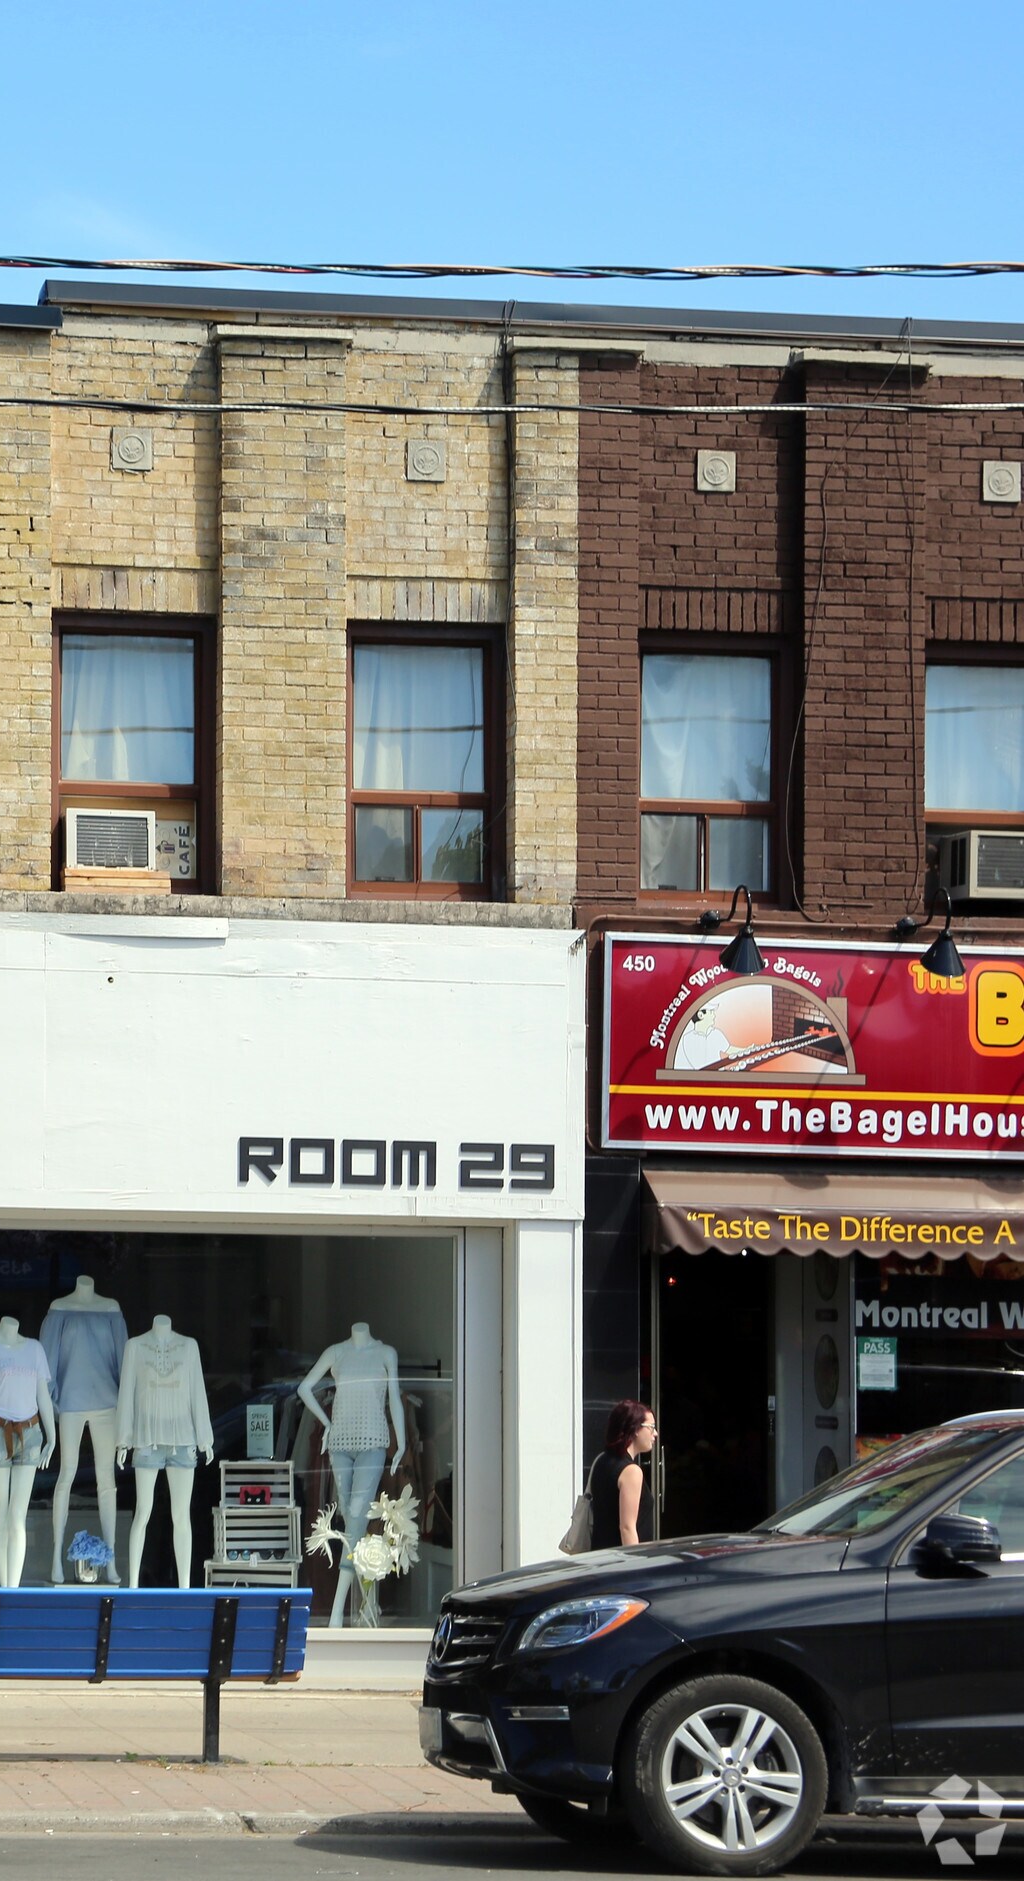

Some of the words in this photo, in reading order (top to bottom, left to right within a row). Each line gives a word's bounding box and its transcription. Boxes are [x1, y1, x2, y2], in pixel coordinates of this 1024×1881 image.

[174, 825, 191, 876] CAFÉ
[623, 955, 655, 972] 450
[649, 983, 692, 1050] Montreal
[773, 956, 822, 988] Bagels
[644, 1099, 1024, 1143] www.TheBagelHou
[238, 1137, 437, 1187] ROOM
[459, 1142, 555, 1190] 29
[778, 1216, 830, 1242] The
[840, 1217, 984, 1246] Difference
[994, 1221, 1017, 1245] A
[855, 1299, 989, 1329] Montreal
[863, 1342, 891, 1354] PASS
[250, 1420, 270, 1432] SALE
